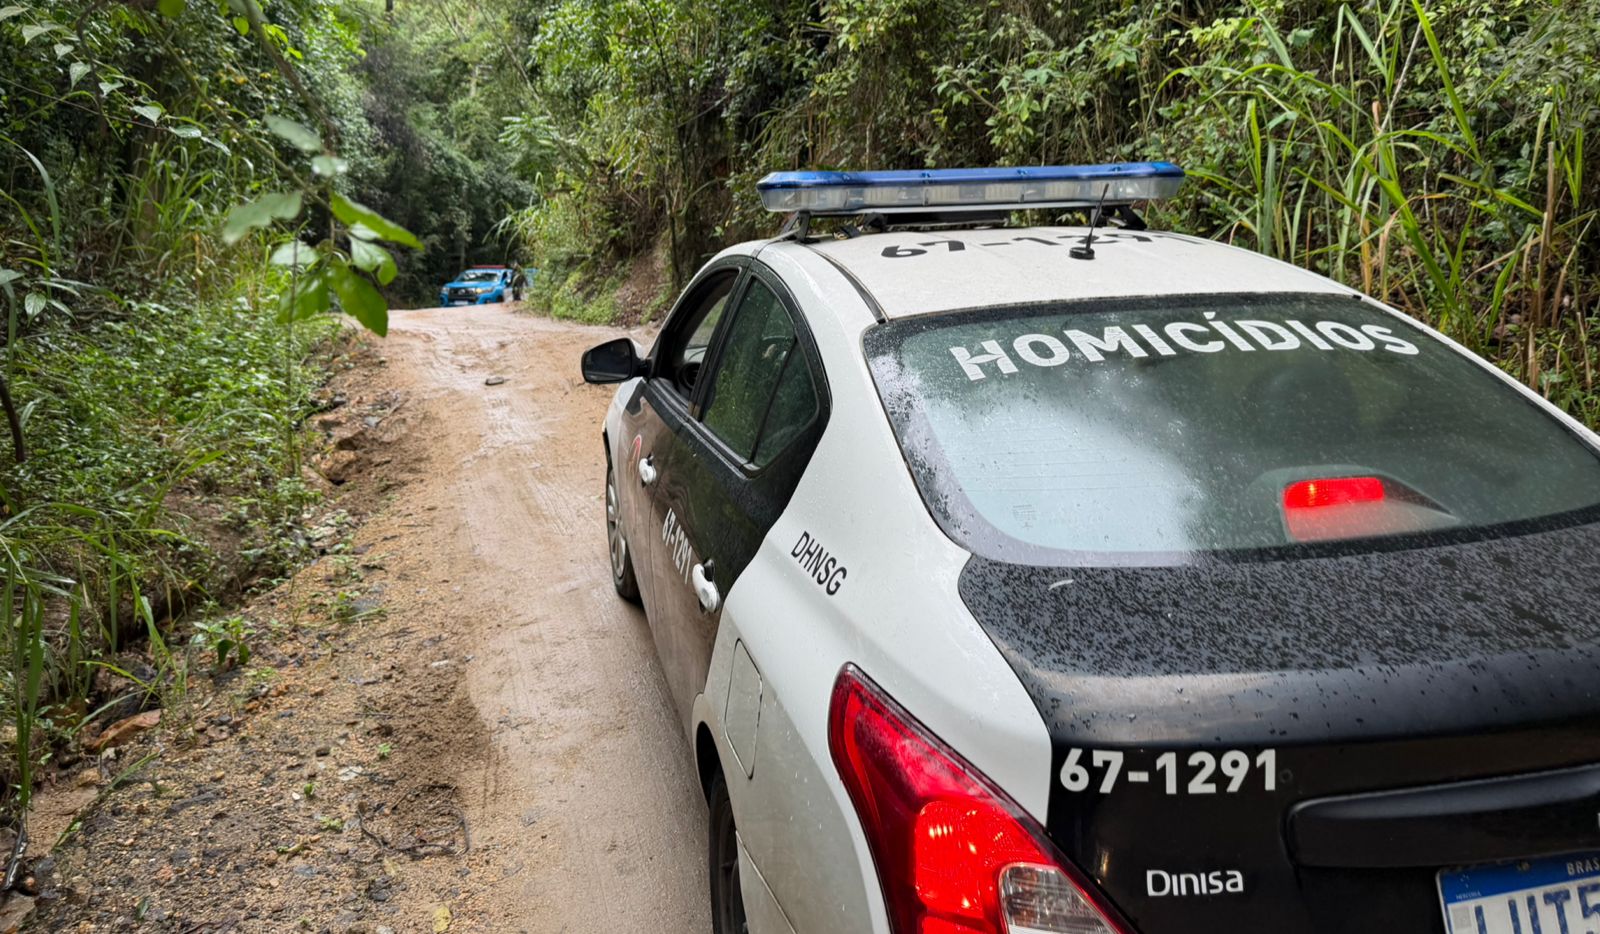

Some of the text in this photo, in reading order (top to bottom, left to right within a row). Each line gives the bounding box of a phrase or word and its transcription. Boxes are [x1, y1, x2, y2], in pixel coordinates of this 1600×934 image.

[881, 233, 1203, 258] 67-1291
[949, 311, 1420, 382] HOMICÍDIOS
[662, 507, 692, 585] 67-1291
[791, 531, 848, 596] DHNSG
[1060, 748, 1276, 794] 67-1291
[1146, 869, 1244, 897] Dinisa
